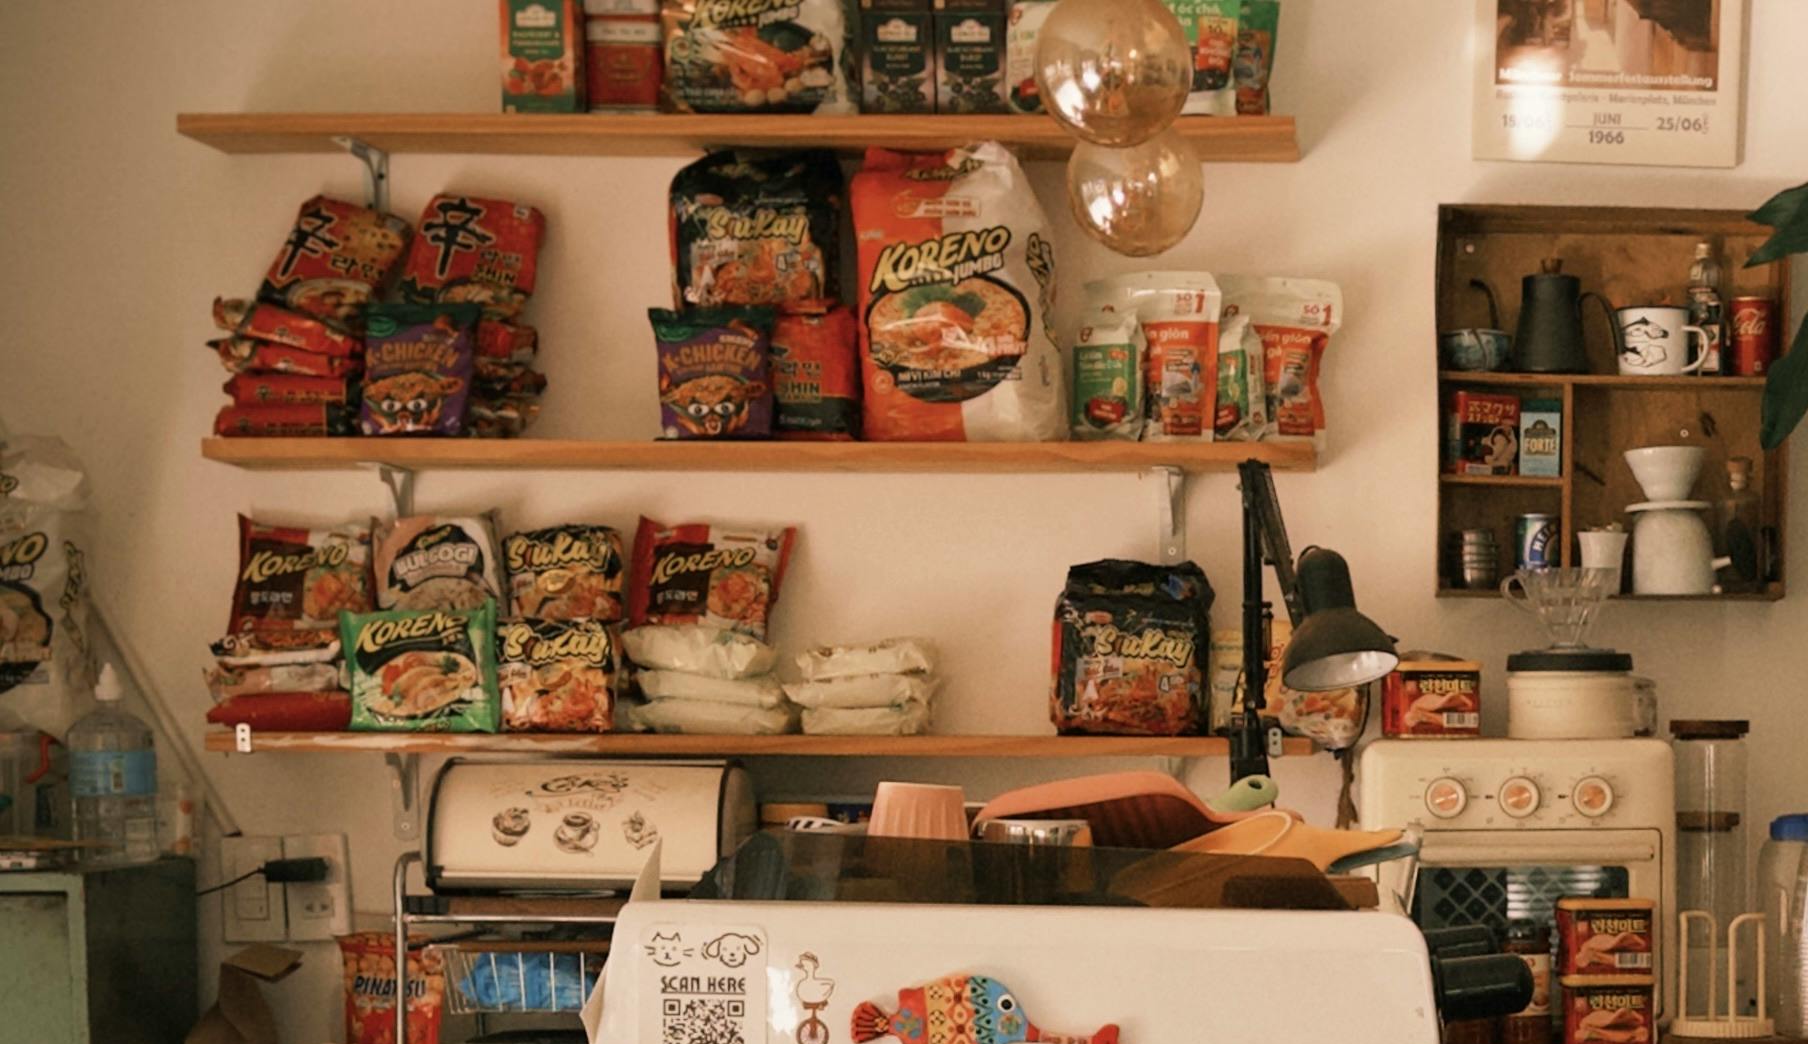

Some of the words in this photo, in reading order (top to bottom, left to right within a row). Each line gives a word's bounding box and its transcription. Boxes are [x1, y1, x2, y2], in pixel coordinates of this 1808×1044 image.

[1592, 112, 1622, 125] JUNI
[1656, 116, 1703, 132] 25/06
[1589, 130, 1625, 145] 1966
[278, 204, 341, 279] 辛
[423, 197, 495, 278] 辛
[474, 264, 516, 284] SHIN
[870, 225, 1012, 293] KORENO
[953, 252, 1004, 285] JUMBO
[366, 341, 460, 369] K-CHICKEN
[663, 343, 761, 372] K-CHICKEN
[242, 542, 350, 583] KORENO
[649, 548, 756, 585] KORENO
[357, 612, 470, 654] KORENO
[660, 976, 701, 993] SCAN
[707, 976, 746, 993] HERE
